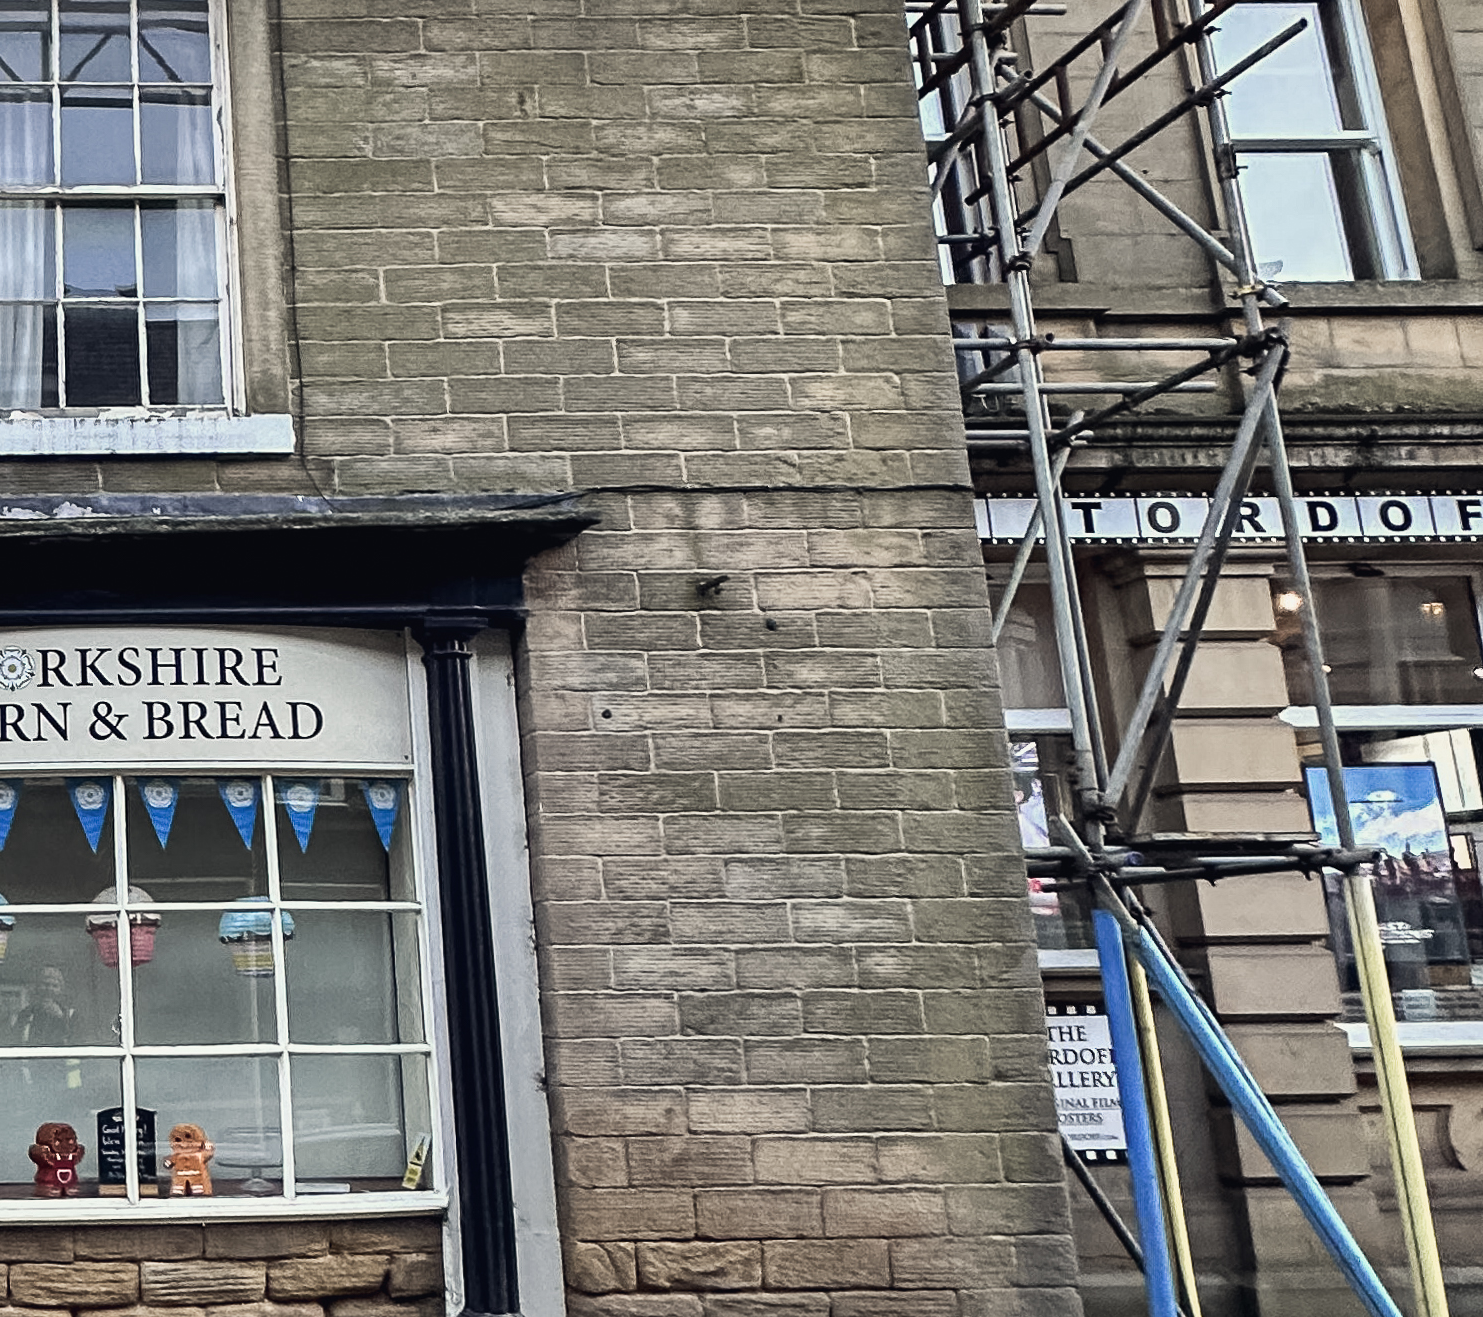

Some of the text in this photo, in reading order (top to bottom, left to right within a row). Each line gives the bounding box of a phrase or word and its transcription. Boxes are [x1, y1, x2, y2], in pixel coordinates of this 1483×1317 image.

[1071, 499, 1483, 535] TORDOF
[89, 701, 129, 741] &
[142, 701, 324, 741] BREAD
[1047, 1025, 1088, 1042] THE
[1048, 1047, 1117, 1065] RDOF
[1053, 1071, 1118, 1088] LLERY
[1059, 1112, 1103, 1124] OSTERS
